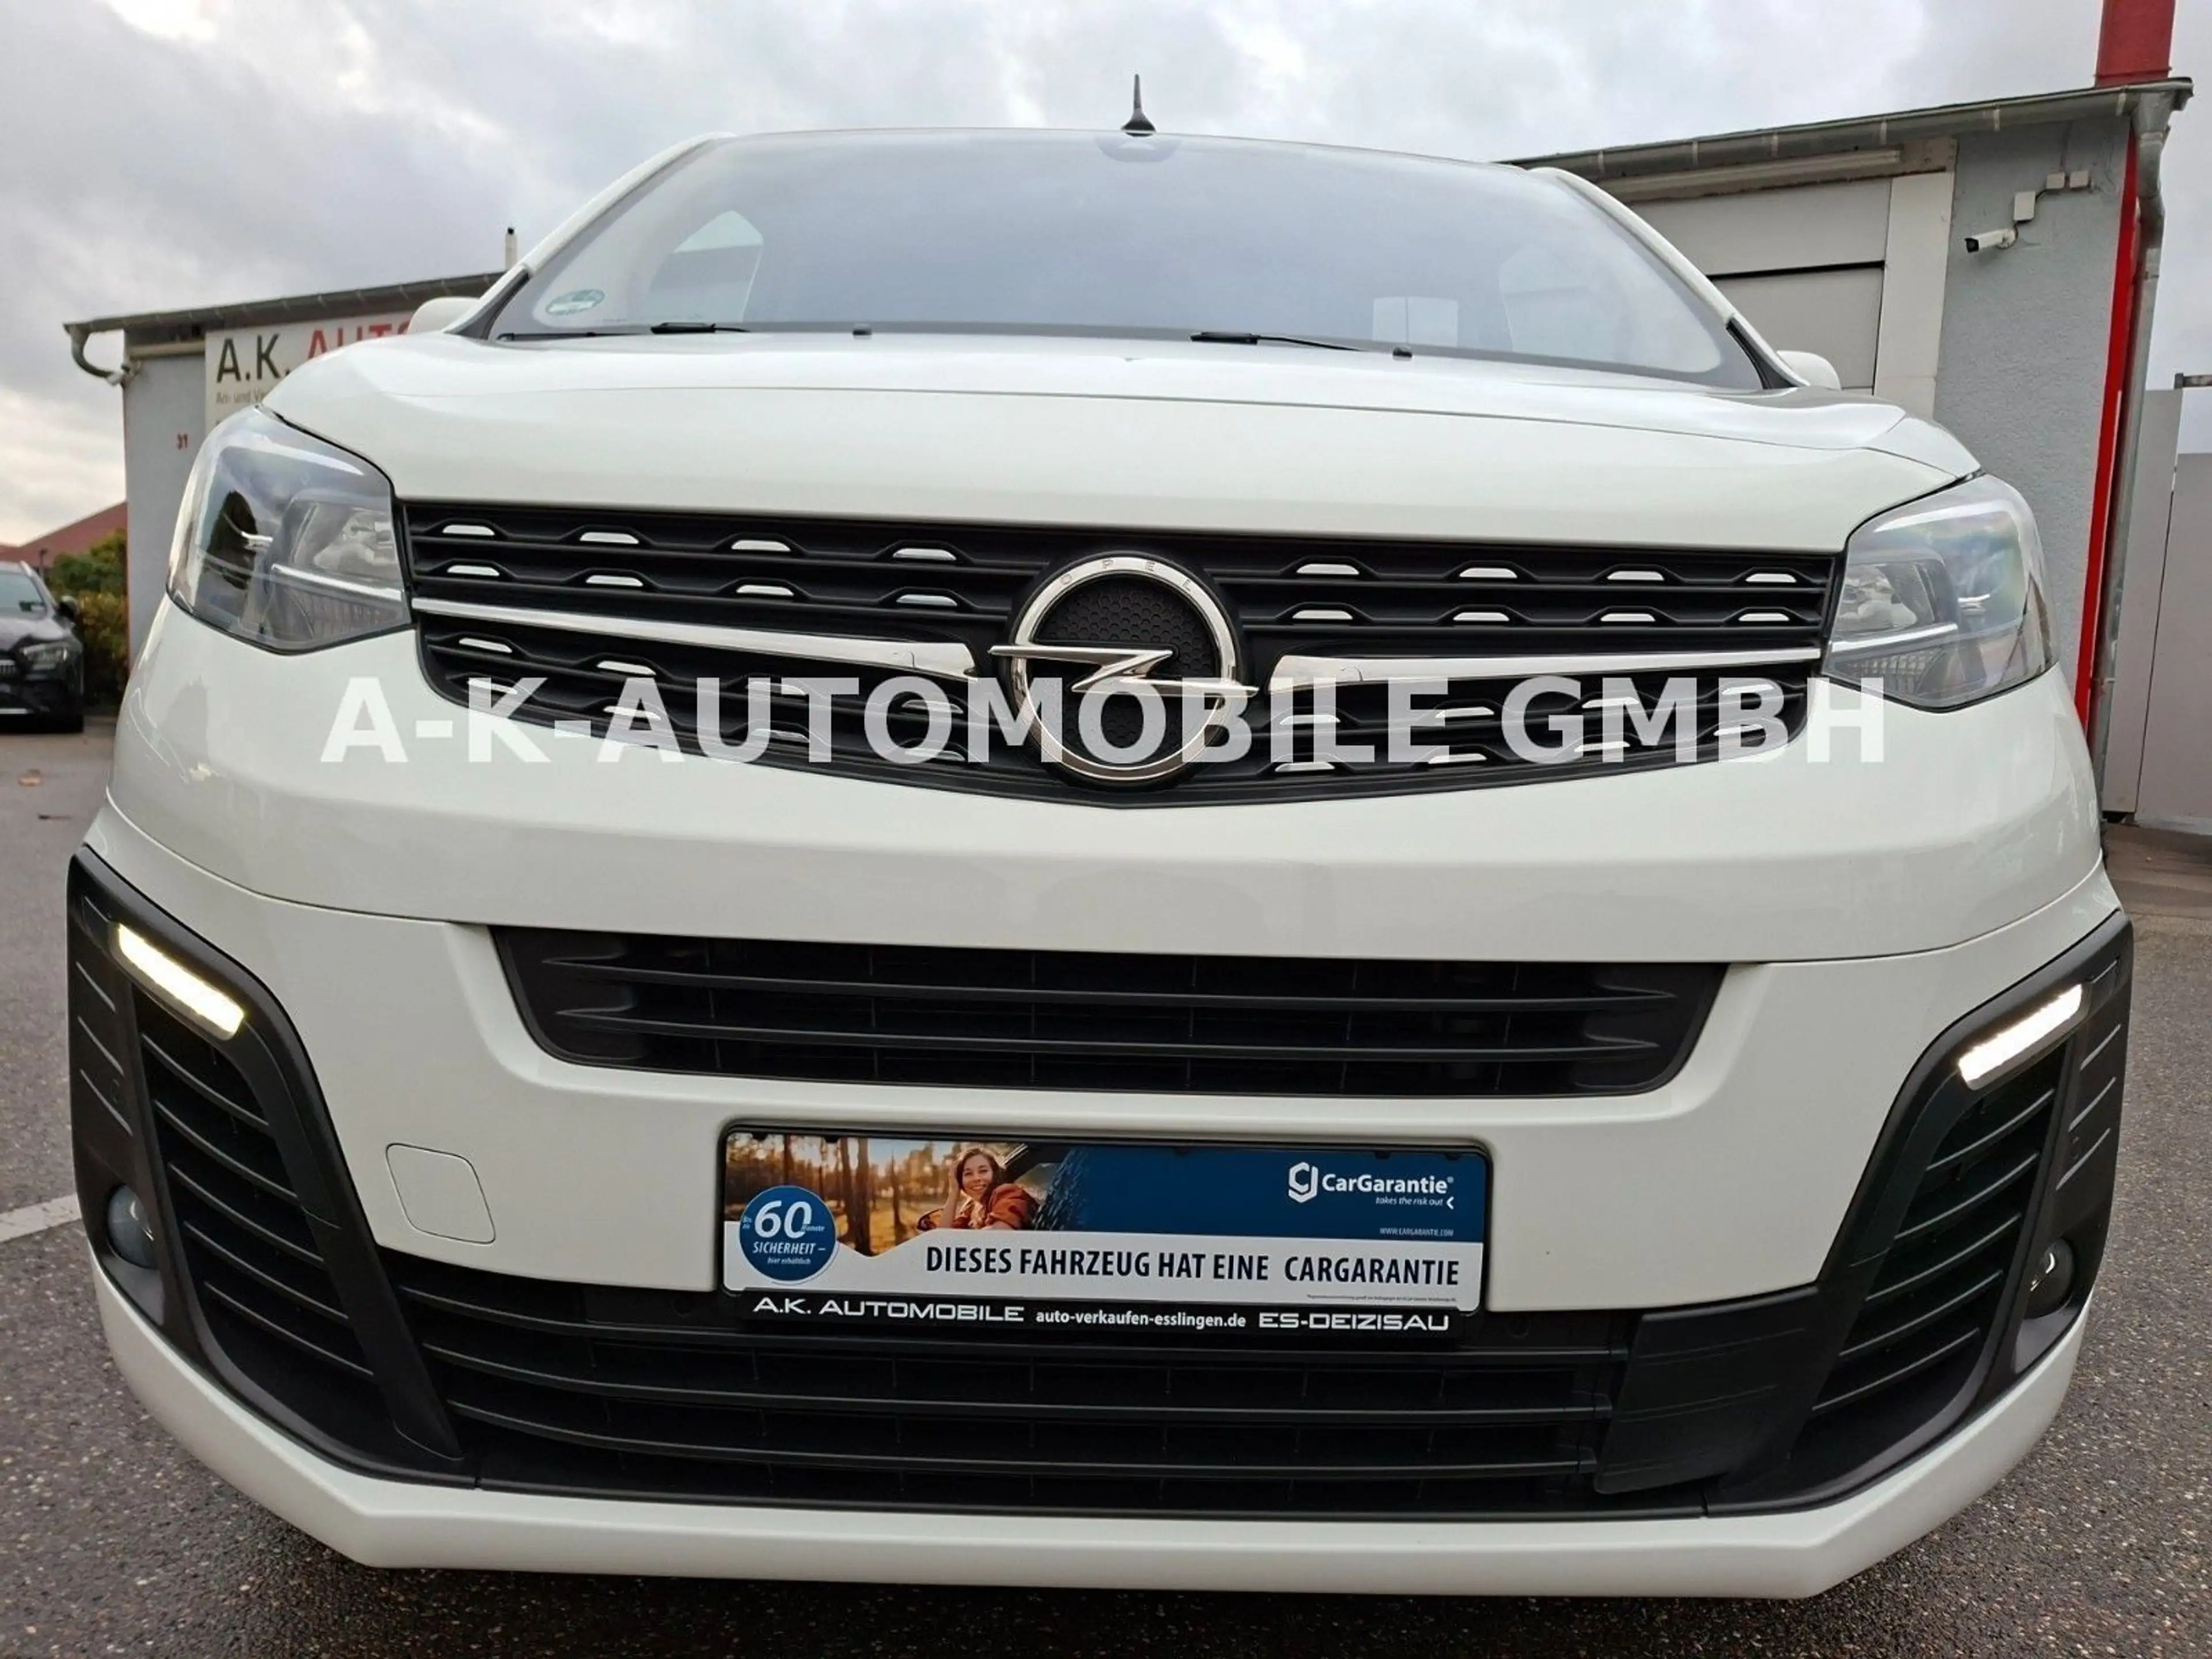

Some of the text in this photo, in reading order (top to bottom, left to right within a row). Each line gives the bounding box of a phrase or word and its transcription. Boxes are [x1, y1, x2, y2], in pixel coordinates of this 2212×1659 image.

[1060, 559, 1191, 592] OPEL
[1376, 1196, 1397, 1205] takes
[1399, 1196, 1412, 1205] the
[1413, 1196, 1427, 1205] risk
[754, 1200, 812, 1239] 60
[752, 1241, 817, 1255] SICHERHEIT
[926, 1247, 1460, 1286] DIESES FAHRZEUG HAT EINE CARGARANTIE
[753, 1297, 1450, 1332] A.K. AUTOMOBILE auto-verkaufen-esslingen.de ES-DEIZISAU
